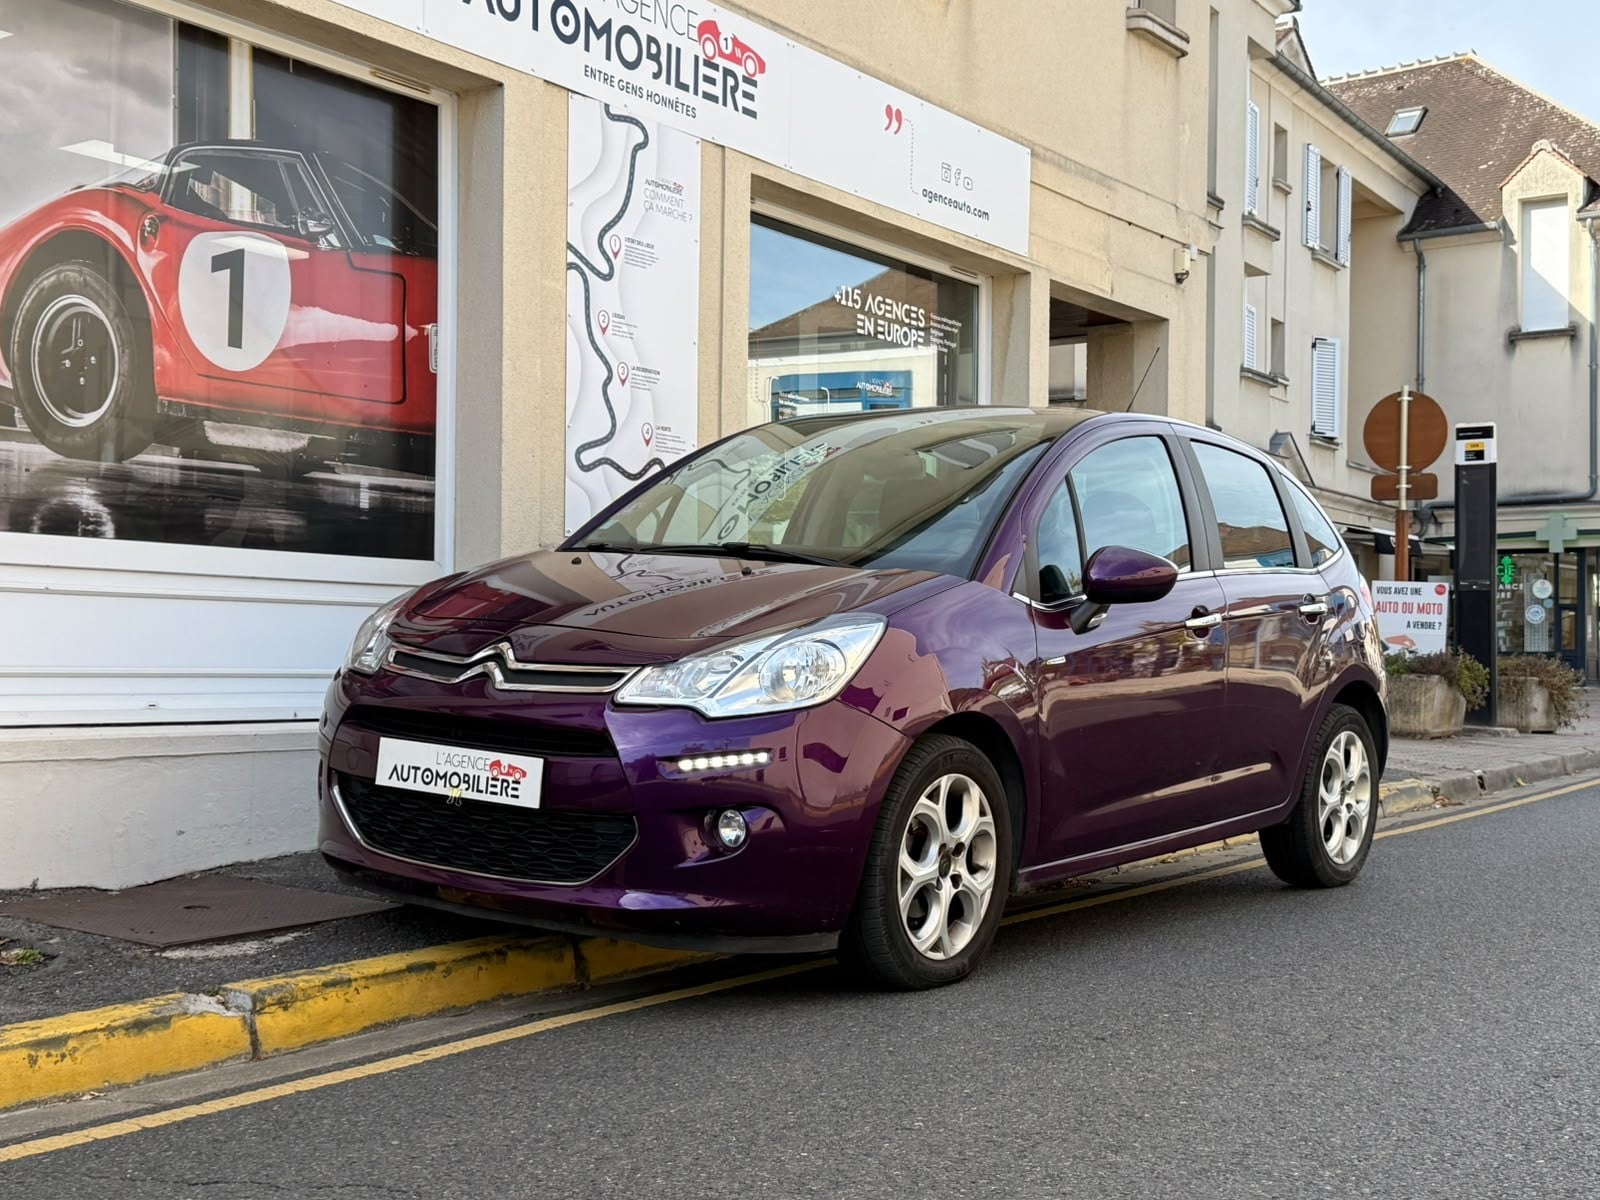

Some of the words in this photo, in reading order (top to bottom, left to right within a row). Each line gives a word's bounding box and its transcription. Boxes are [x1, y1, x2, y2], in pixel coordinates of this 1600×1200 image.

[584, 64, 616, 89] ENTRE
[617, 78, 644, 99] GENS
[646, 89, 697, 119] HONNÊTES
[644, 188, 684, 208] COMMENT
[922, 187, 990, 221] agenceauto.com
[655, 203, 688, 222] MARCHE
[211, 248, 245, 350] 1
[601, 314, 607, 324] 2
[865, 293, 925, 328] AGENCES
[857, 313, 875, 337] EN
[878, 319, 925, 349] EUROPE
[620, 365, 626, 376] 3
[1376, 586, 1392, 595] VOUS
[1393, 587, 1408, 595] AVEZ
[1410, 587, 1422, 596] UNE
[1375, 601, 1398, 614] AUTO
[1402, 602, 1414, 614] OU
[1417, 603, 1443, 615] MOTO
[1413, 621, 1436, 630] VENDRE
[1437, 622, 1442, 630] ?
[436, 752, 490, 771] L'AGENCE
[388, 764, 521, 799] AUTOMOBILIERE
